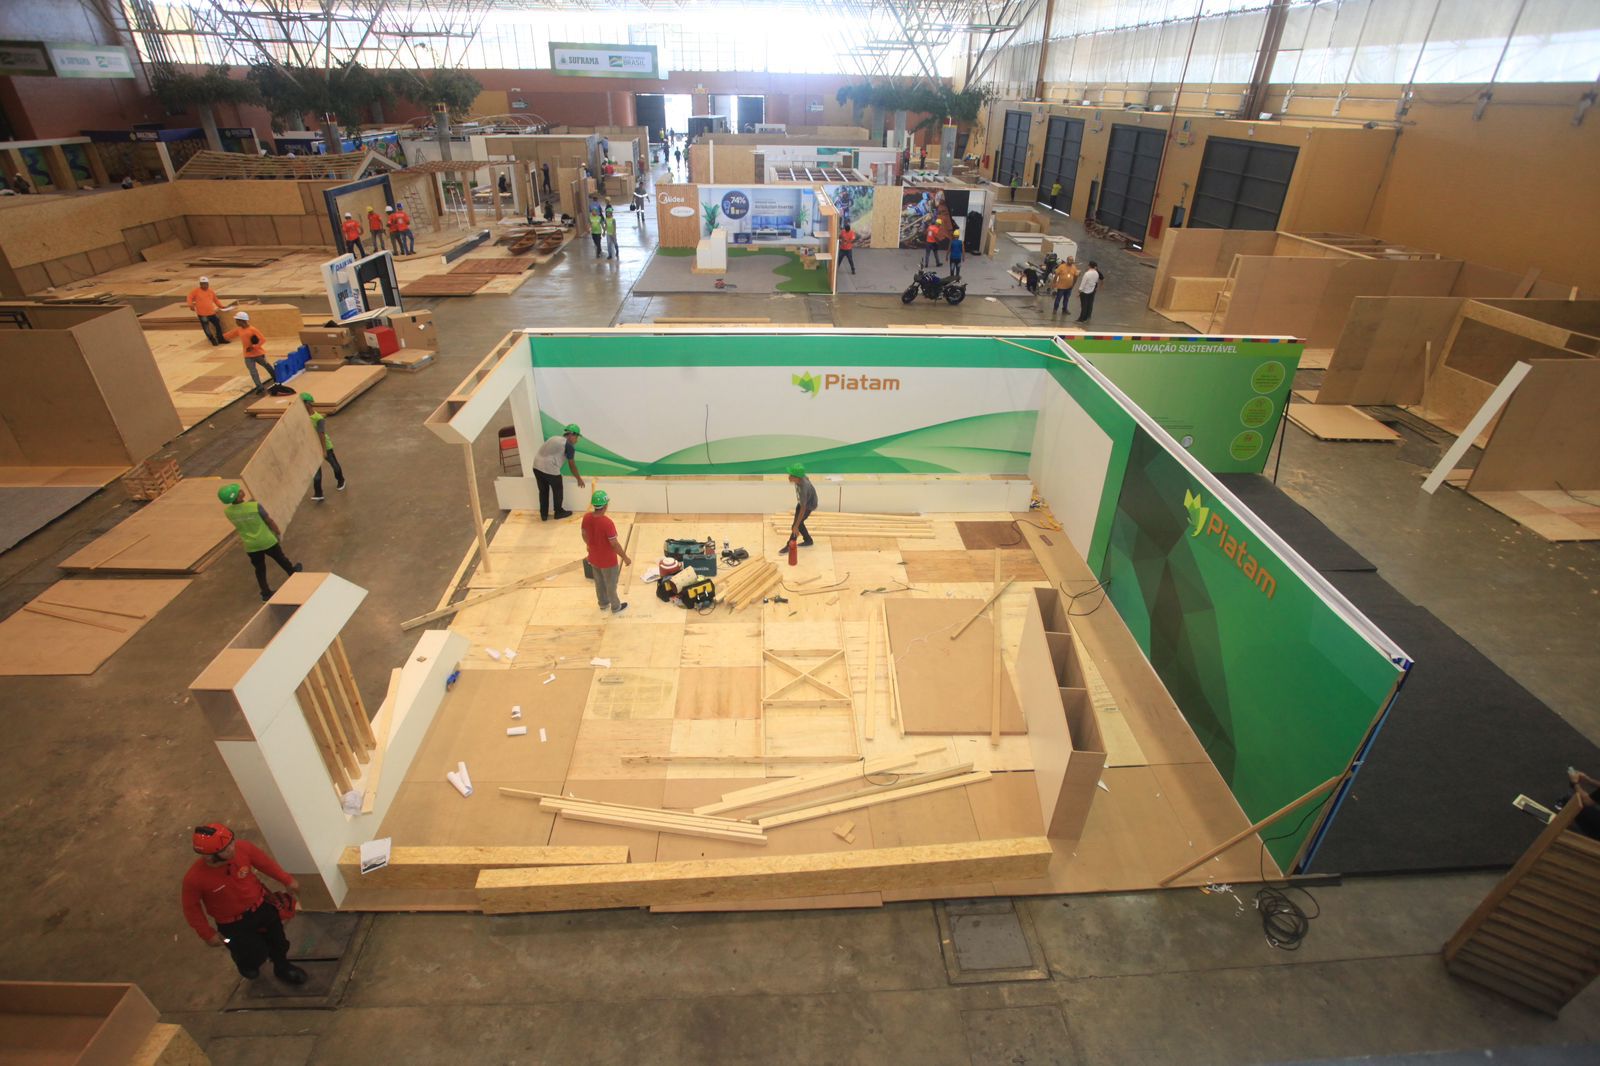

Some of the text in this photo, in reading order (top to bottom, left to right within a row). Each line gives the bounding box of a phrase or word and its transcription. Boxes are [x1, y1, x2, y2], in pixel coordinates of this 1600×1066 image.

[568, 56, 600, 65] SUFRAMA
[730, 196, 747, 205] 74%
[1131, 342, 1238, 354] INOVAÇÃO SUSTENTÁVEL
[825, 374, 900, 391] Piatam
[1207, 513, 1277, 599] Piatam
